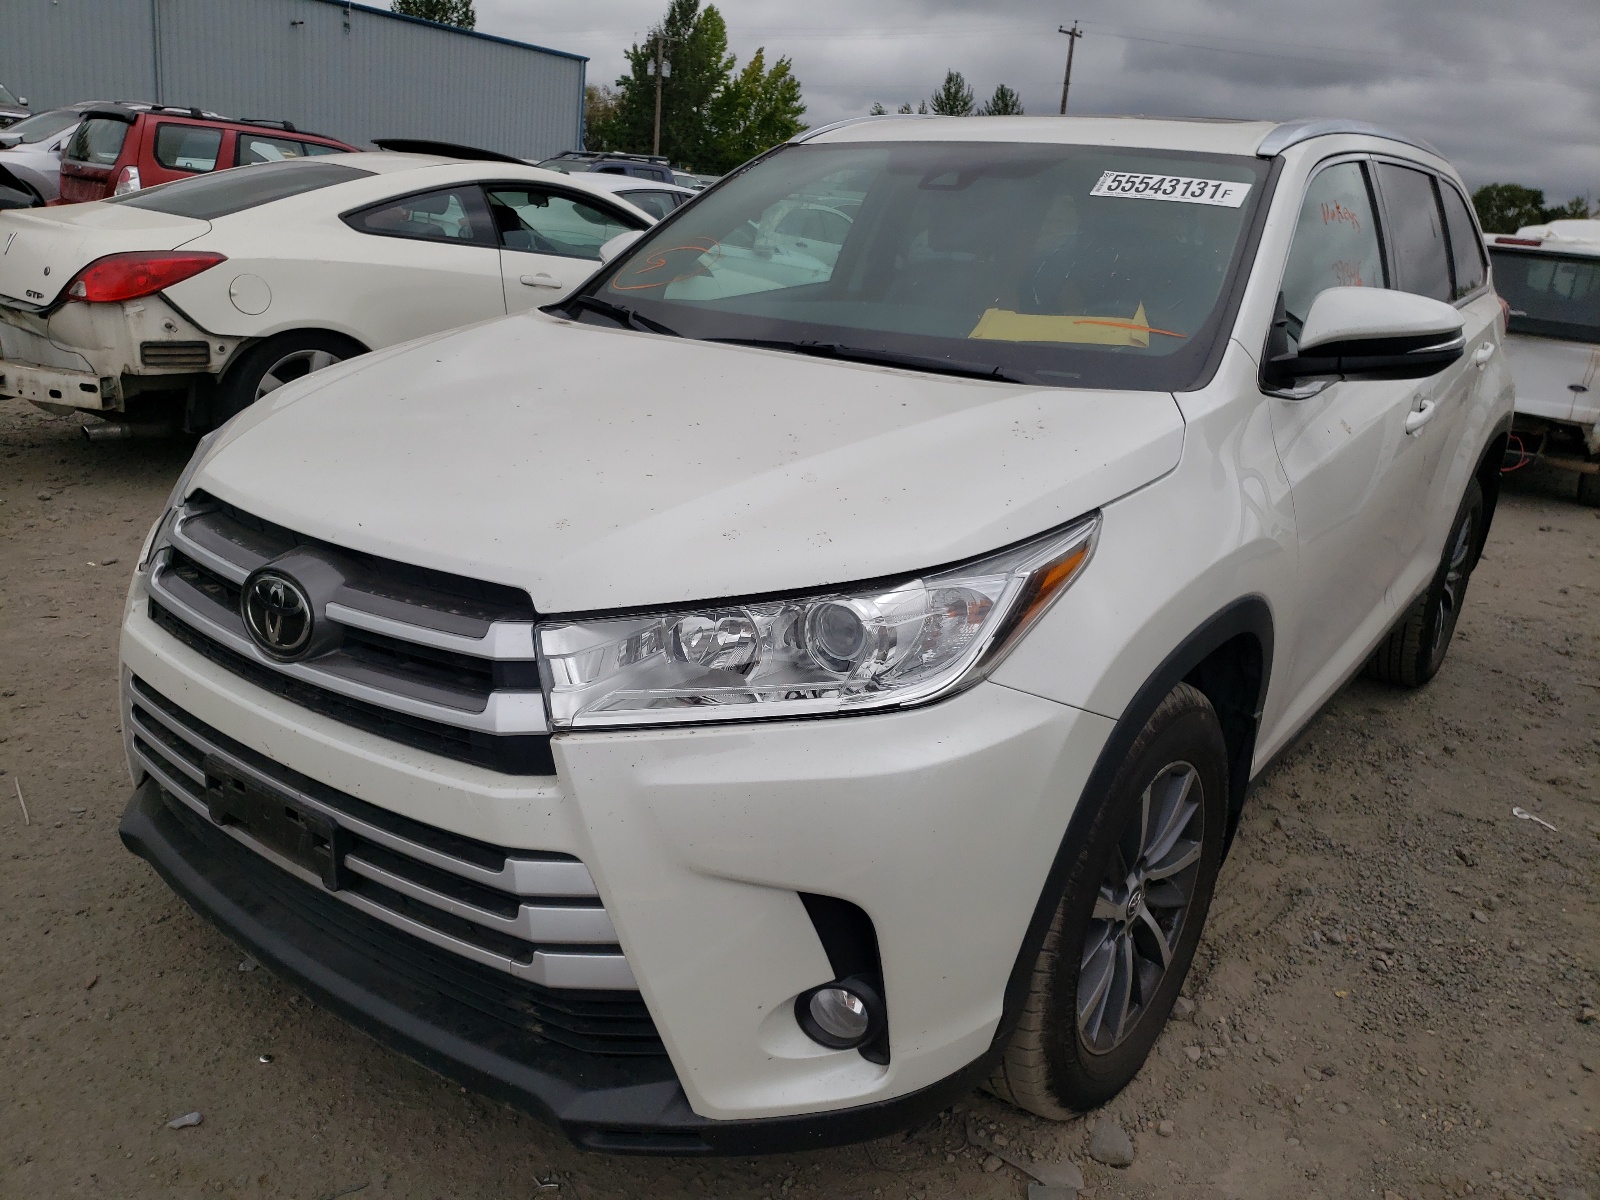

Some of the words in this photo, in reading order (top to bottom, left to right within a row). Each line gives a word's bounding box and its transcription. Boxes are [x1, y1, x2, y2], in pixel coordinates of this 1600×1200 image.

[1107, 174, 1222, 199] 55543131
[1221, 189, 1233, 199] F
[26, 289, 43, 299] GTP
